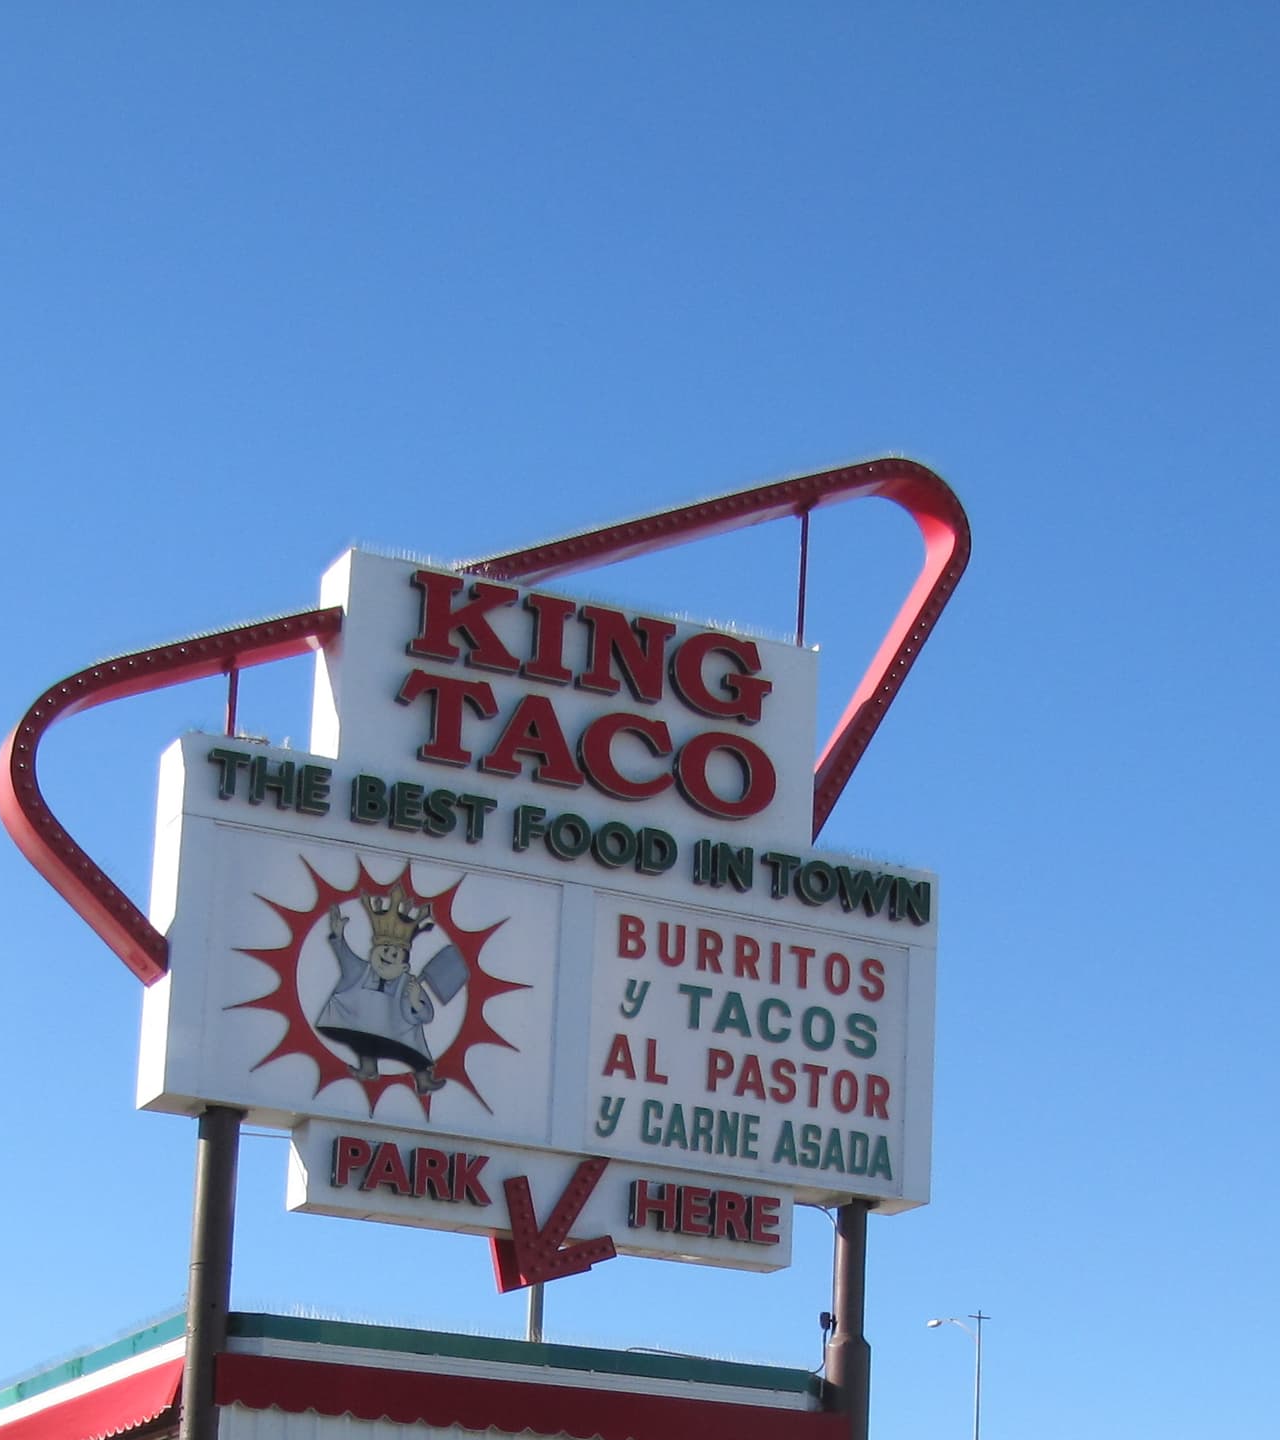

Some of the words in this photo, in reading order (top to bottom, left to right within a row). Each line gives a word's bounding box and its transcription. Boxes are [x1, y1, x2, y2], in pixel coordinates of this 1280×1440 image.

[407, 570, 772, 724] KING
[396, 670, 776, 820] TACO
[208, 748, 332, 815] THE
[351, 774, 498, 843] BEST
[513, 804, 678, 876] FOOD
[693, 839, 754, 893] IN
[761, 852, 931, 927] TOWN
[618, 914, 886, 1002] BURRITOS
[620, 978, 651, 1019] y
[678, 983, 878, 1059] TACOS
[602, 1033, 669, 1085] AL
[706, 1048, 891, 1121] PASTOR
[595, 1096, 625, 1138] y
[640, 1099, 760, 1160] CARNE
[773, 1119, 893, 1181] ASADA
[331, 1135, 492, 1207] PARK
[628, 1179, 781, 1245] HERE
